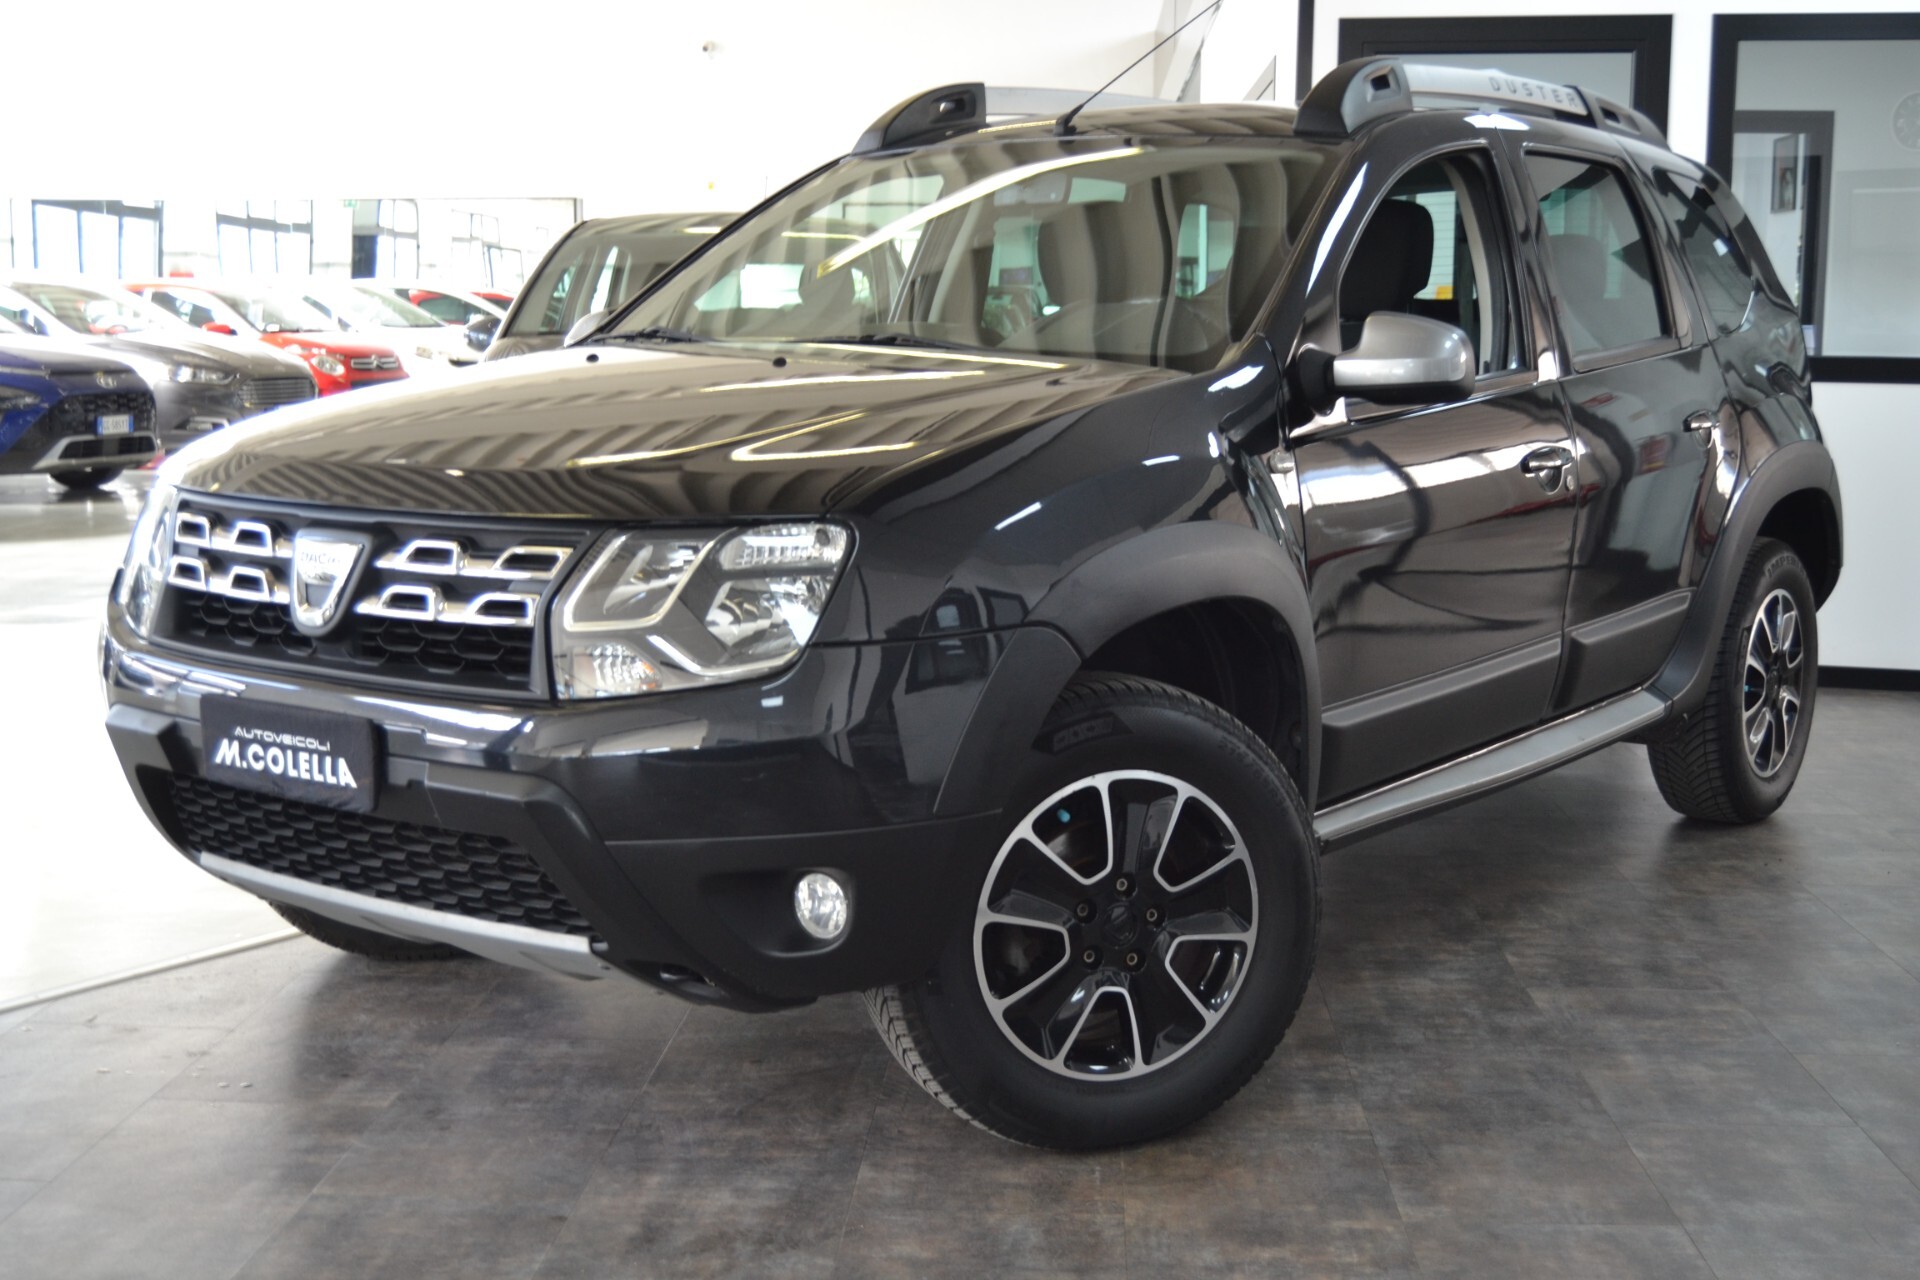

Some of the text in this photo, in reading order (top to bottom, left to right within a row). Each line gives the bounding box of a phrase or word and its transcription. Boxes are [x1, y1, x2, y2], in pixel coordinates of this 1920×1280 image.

[1489, 77, 1577, 107] DUSTER
[234, 726, 330, 751] AUTOVEICOLI
[215, 738, 357, 788] M.COLELLA
